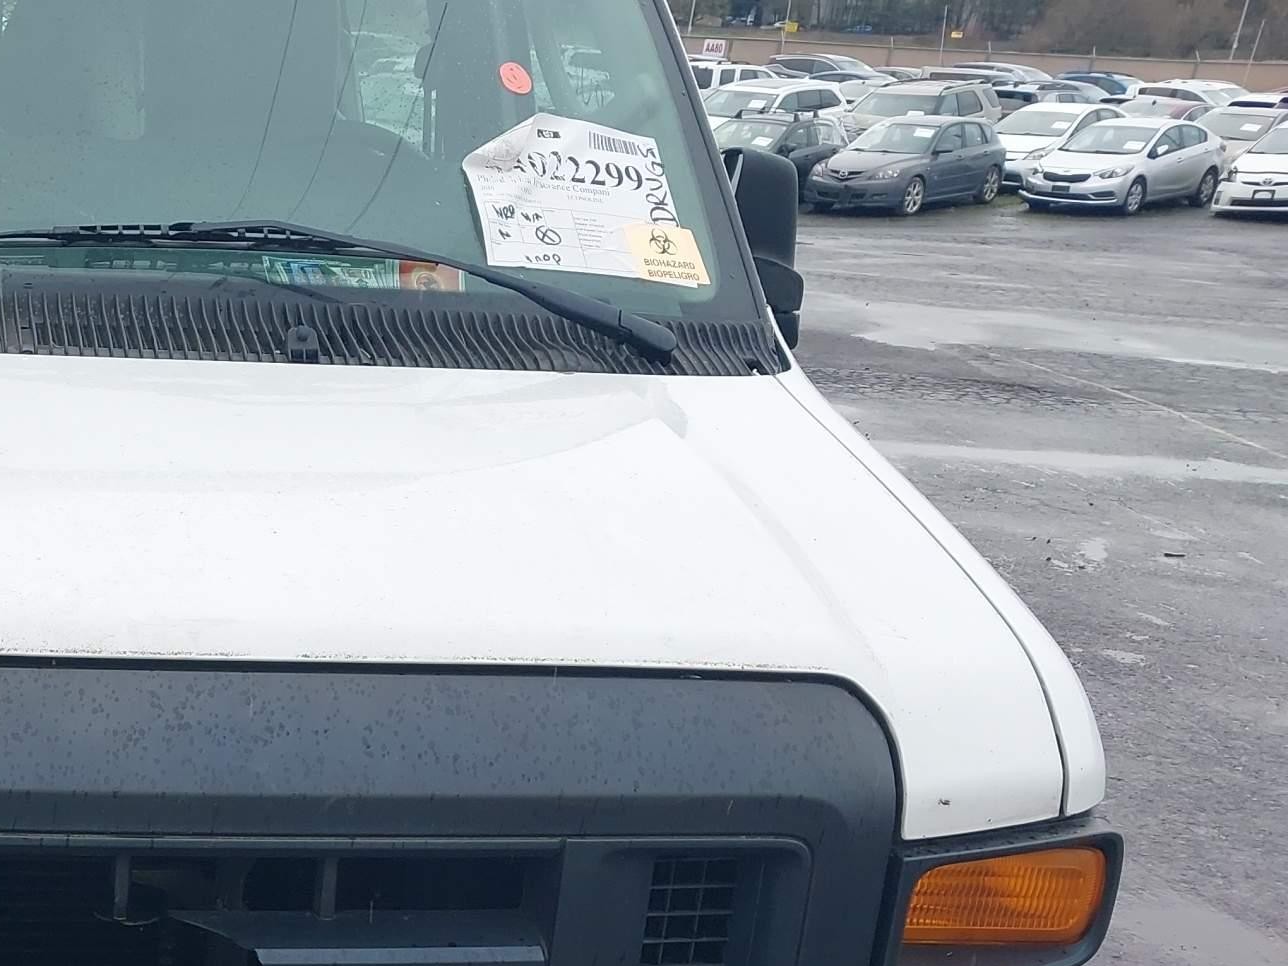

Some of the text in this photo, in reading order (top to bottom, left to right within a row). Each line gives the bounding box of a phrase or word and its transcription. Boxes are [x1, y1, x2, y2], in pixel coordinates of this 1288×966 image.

[636, 144, 680, 228] DRUGS
[644, 258, 696, 270] BIOHAZARD
[648, 268, 700, 282] BIOPELIGRO
